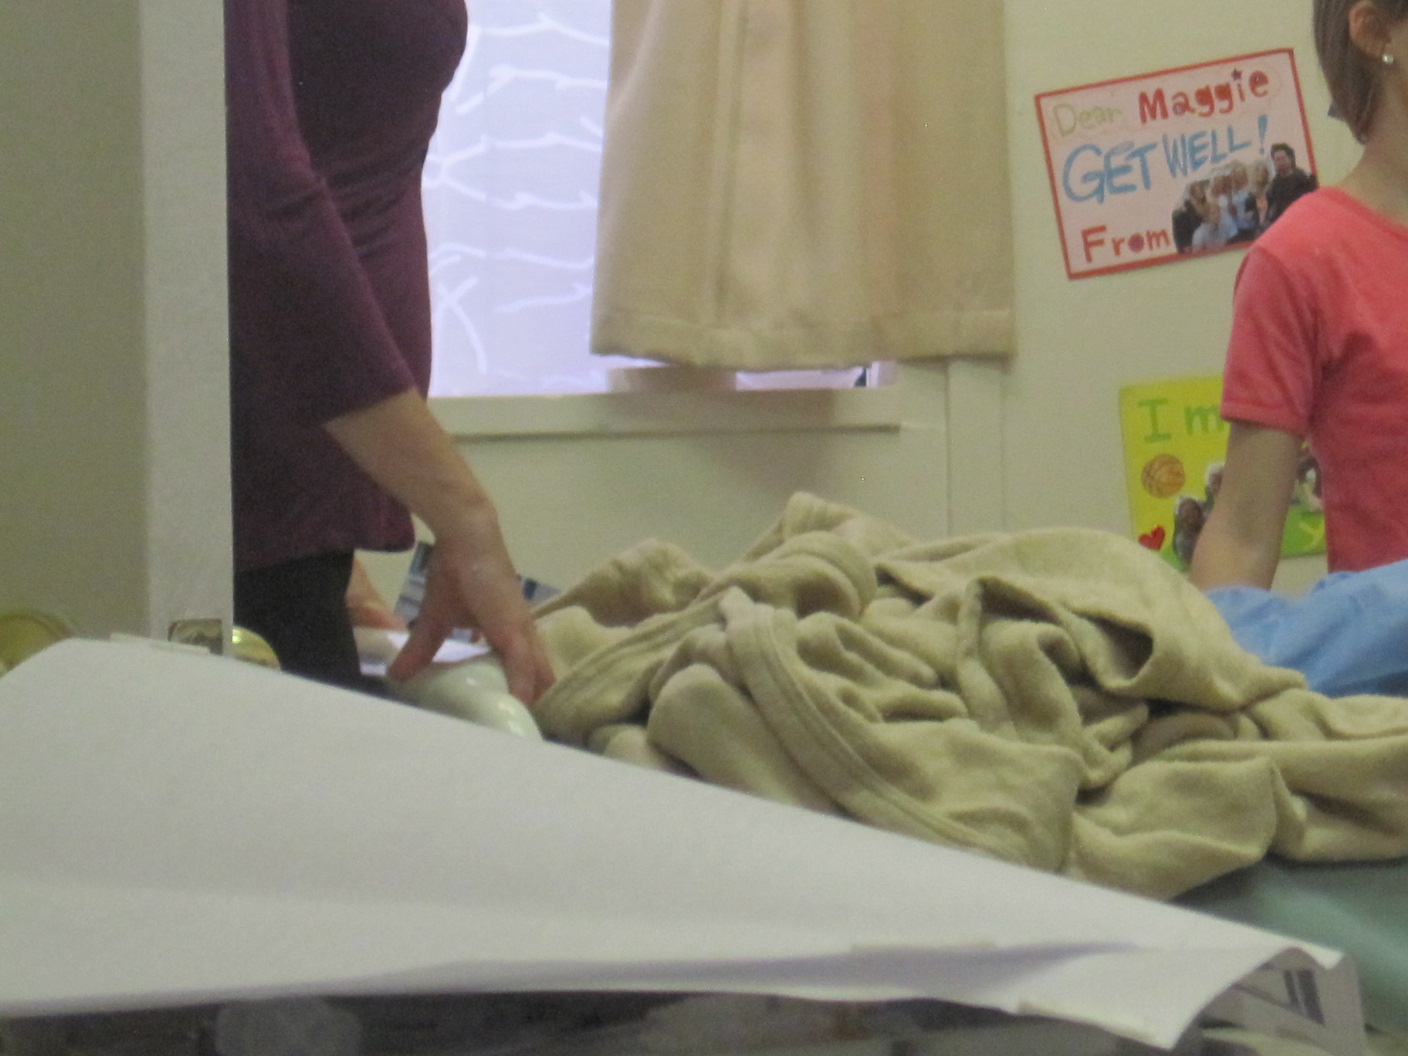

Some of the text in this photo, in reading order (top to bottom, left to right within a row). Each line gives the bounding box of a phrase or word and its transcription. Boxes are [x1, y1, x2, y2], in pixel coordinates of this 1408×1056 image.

[1052, 68, 1270, 138] Dear Maggie
[1062, 141, 1158, 205] GET
[1080, 224, 1172, 264] From
[1136, 397, 1173, 444] I
